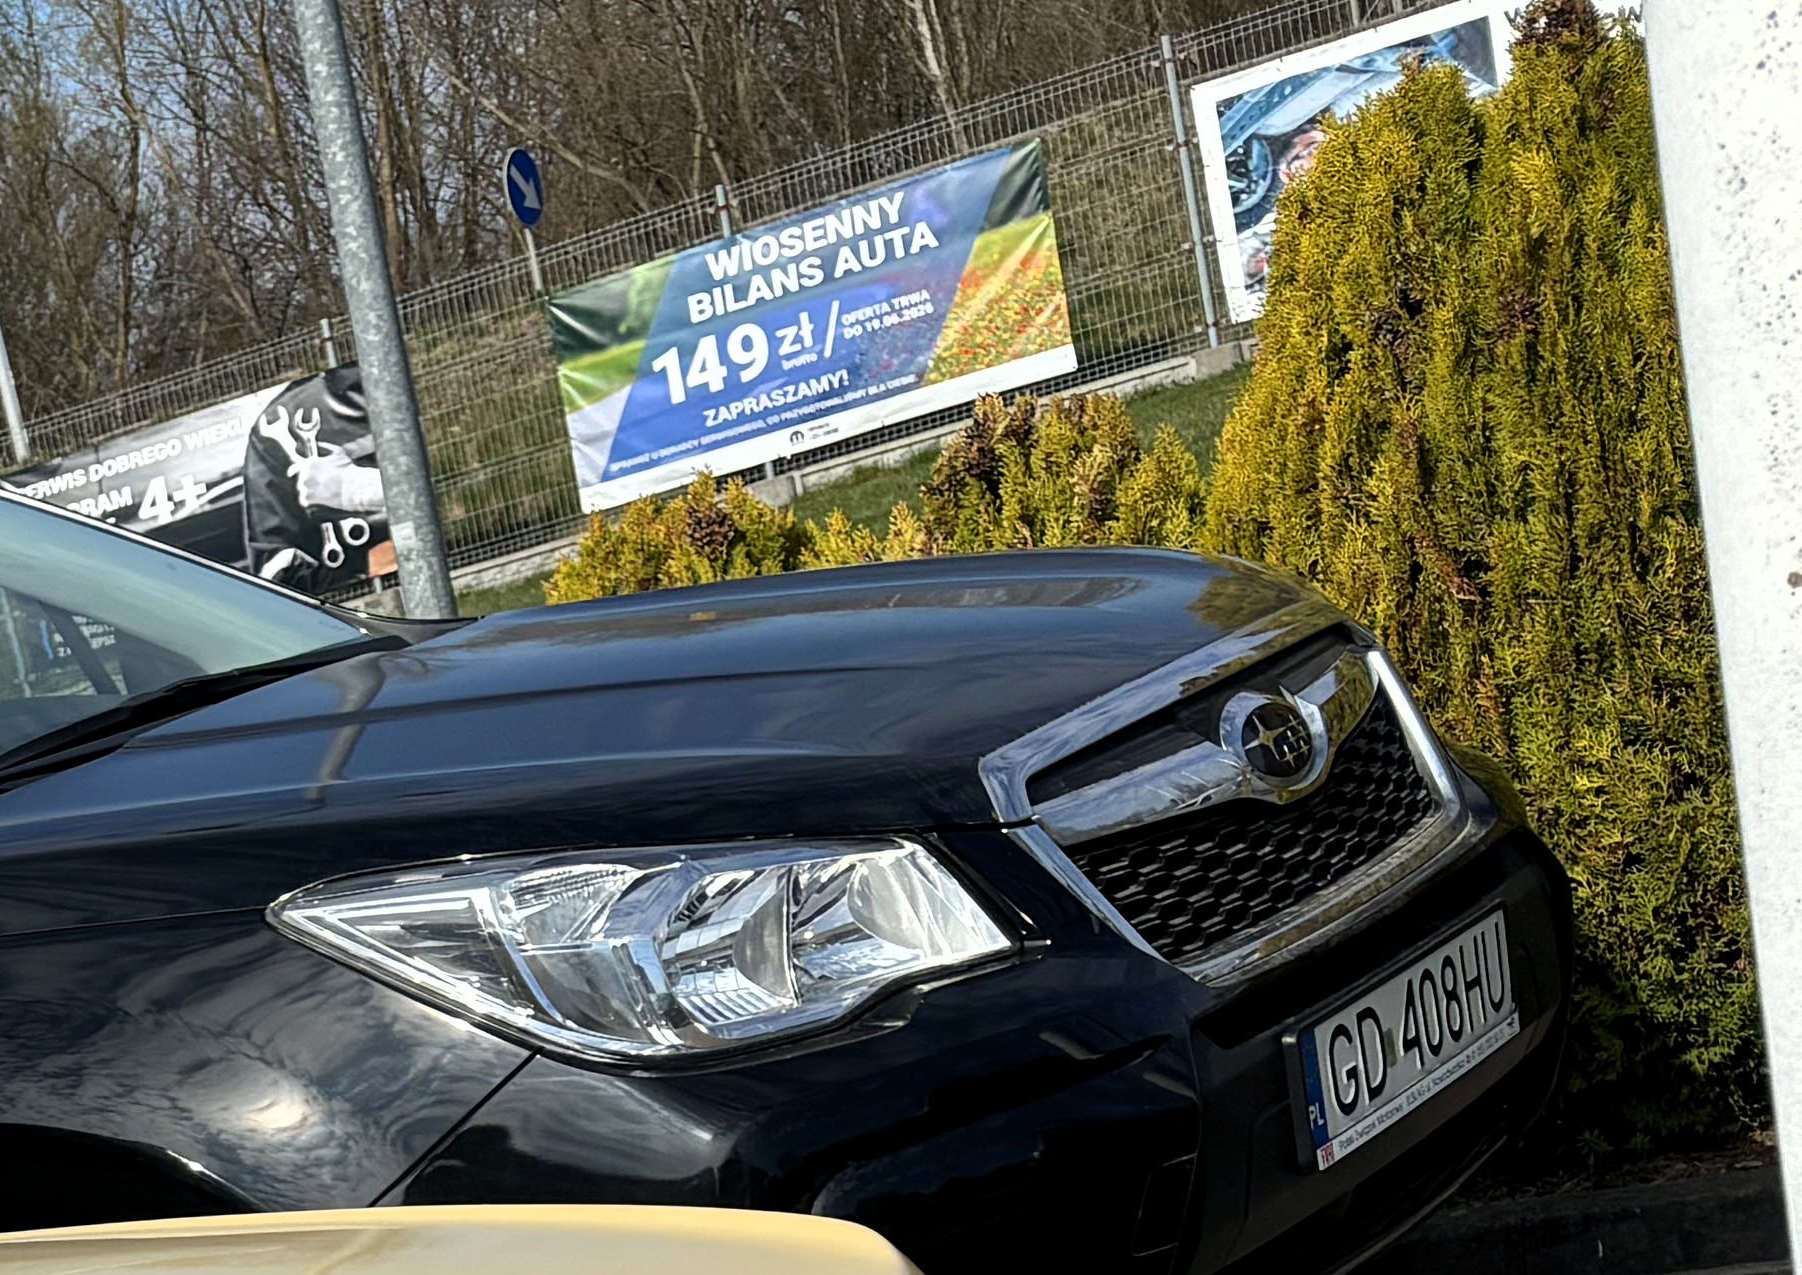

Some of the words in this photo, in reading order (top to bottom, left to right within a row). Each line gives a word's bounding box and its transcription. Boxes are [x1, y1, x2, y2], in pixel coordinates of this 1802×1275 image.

[687, 257, 824, 324] BILANS
[834, 221, 939, 278] AUTA
[705, 192, 904, 280] WIOSENNY
[891, 289, 931, 310] TRWA
[652, 324, 769, 404] 149
[775, 311, 814, 354] zł
[703, 369, 849, 428] ZAPRASZAMY!
[89, 438, 182, 484] DOBREGO
[1309, 1102, 1325, 1129] PL
[1328, 1006, 1388, 1117] GD
[1400, 920, 1506, 1070] 408HU
